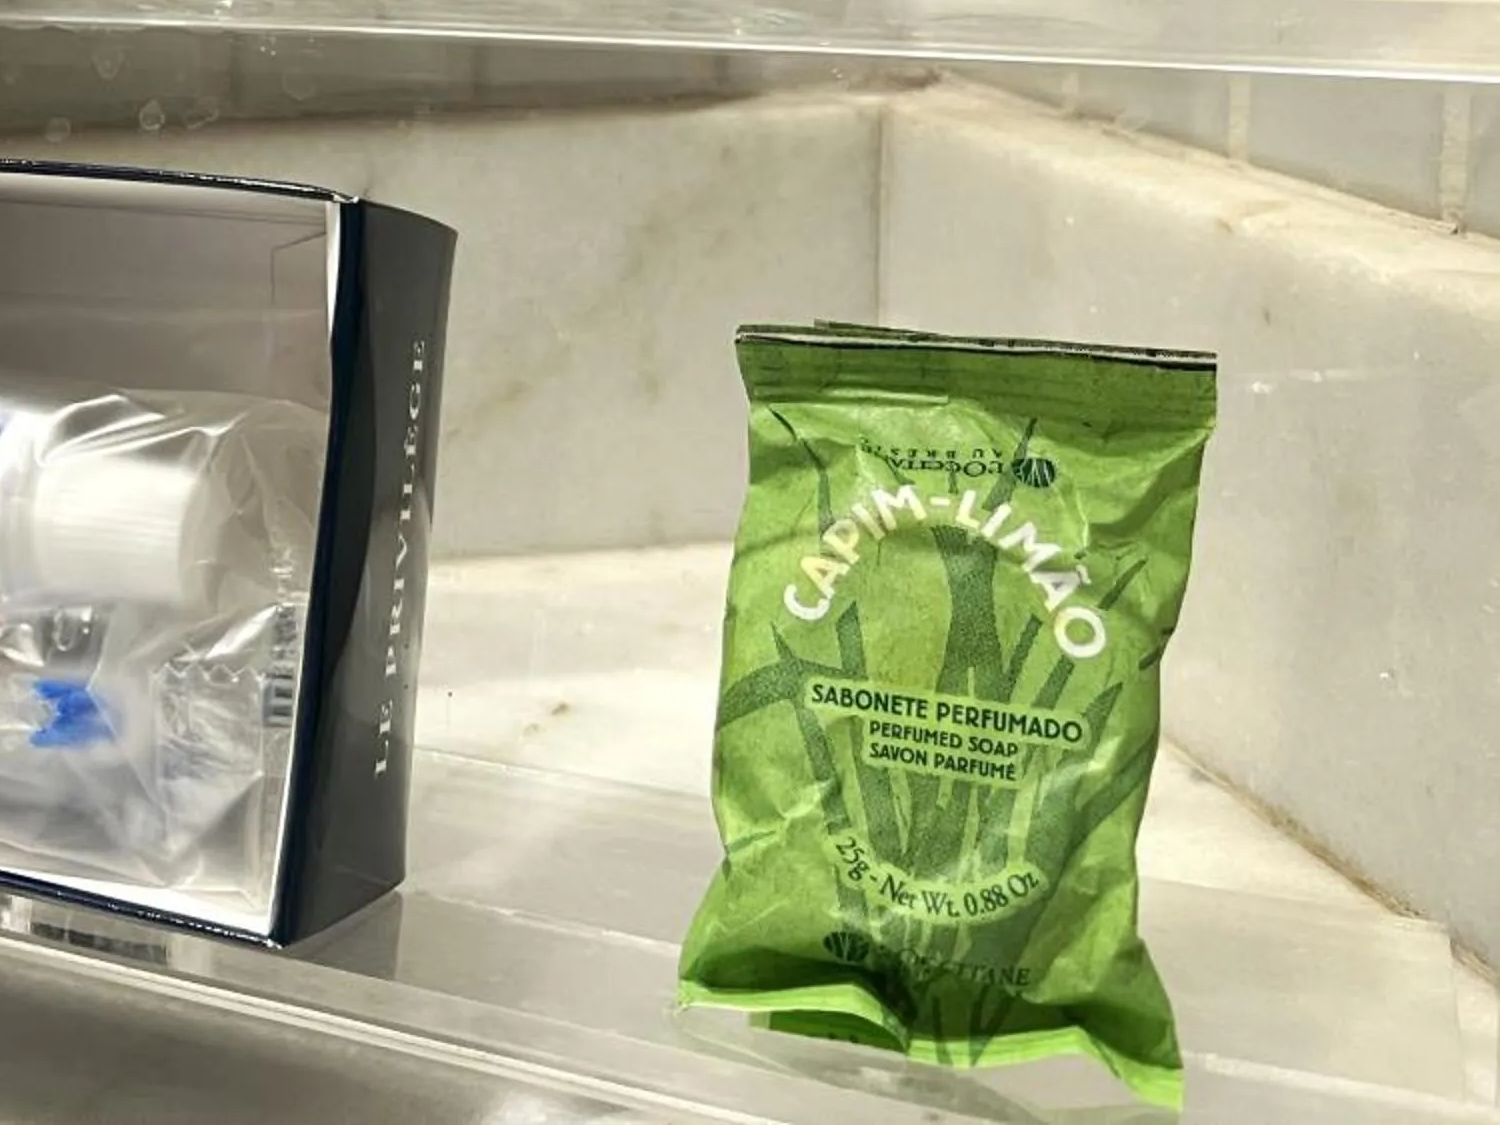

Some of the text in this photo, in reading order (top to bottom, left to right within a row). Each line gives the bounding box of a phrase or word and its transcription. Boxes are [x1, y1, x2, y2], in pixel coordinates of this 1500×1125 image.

[783, 483, 1108, 660] CAPIM-LIMÃO
[373, 699, 394, 779] LE
[811, 683, 1084, 744] SABONETE PERFUMADO
[869, 719, 1020, 759] PERFUMED SOAP
[869, 742, 1017, 782] SAVON PARFUMÉ
[834, 837, 867, 883] 25g
[879, 874, 917, 912] Net
[921, 892, 962, 919] Wt.
[963, 889, 1010, 919] 0.88
[1009, 871, 1041, 902] Oz
